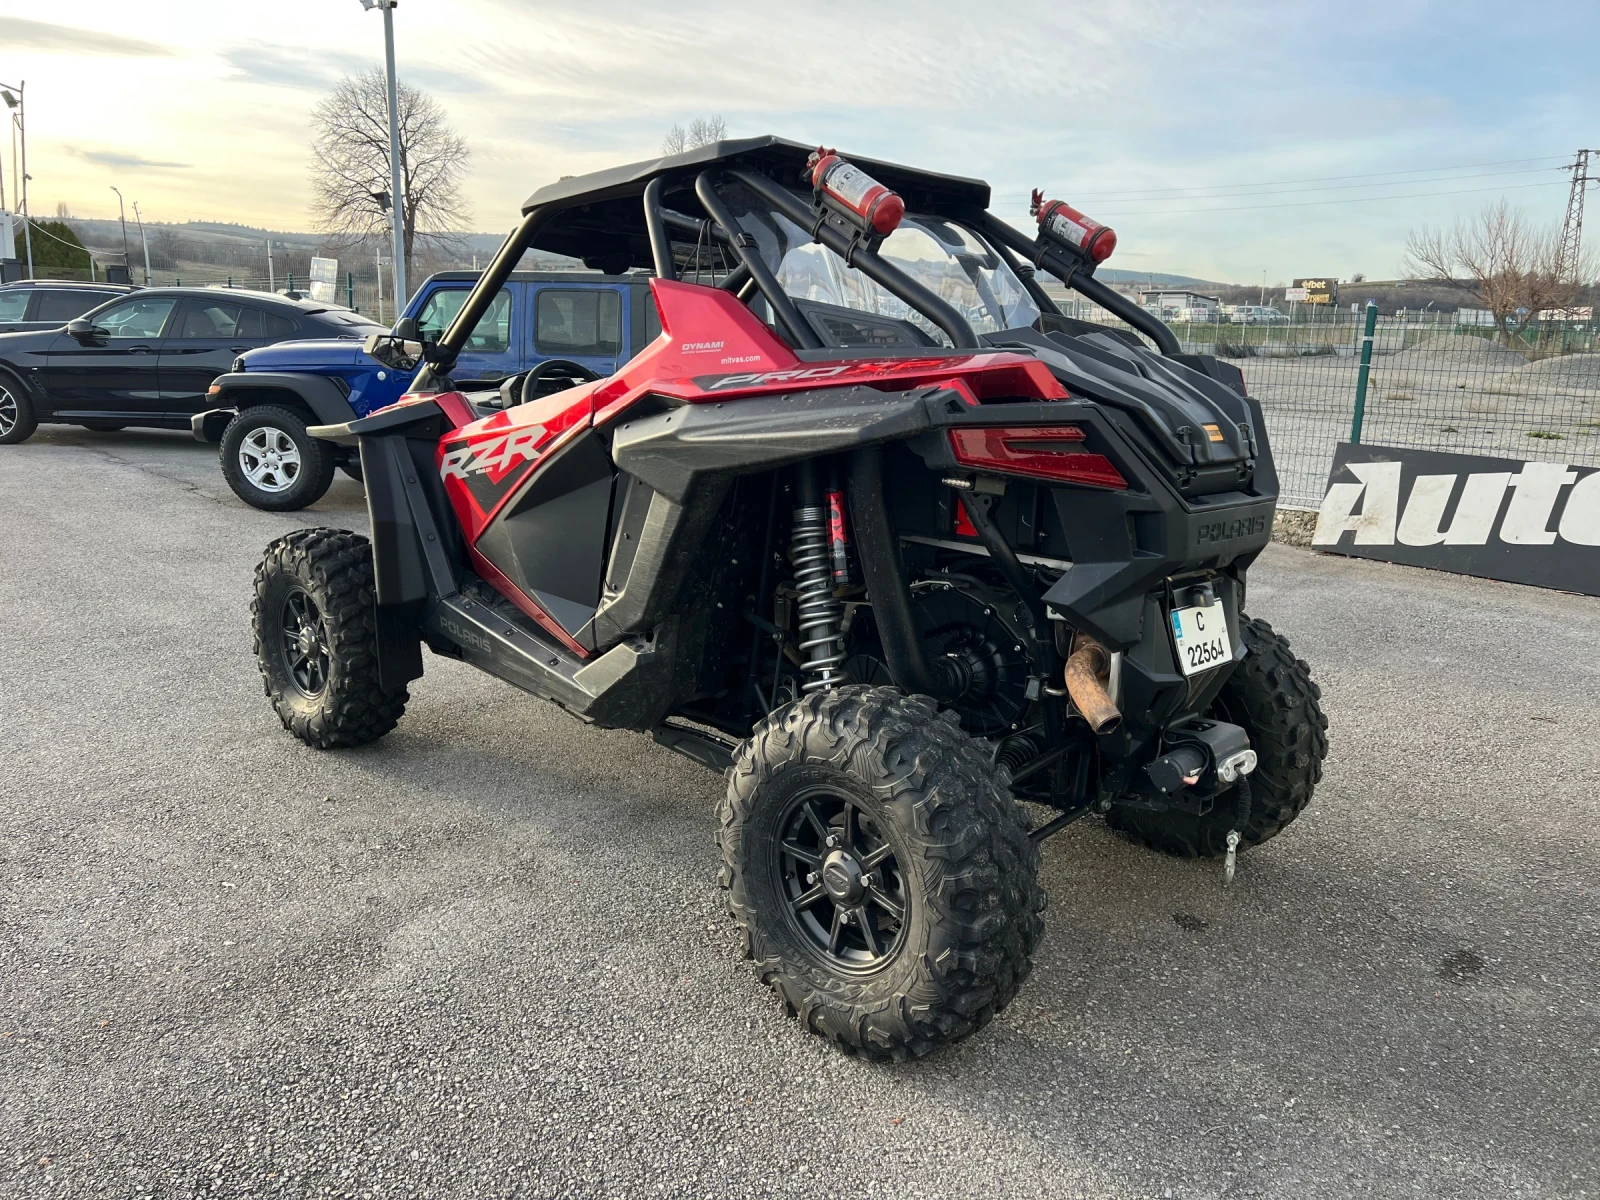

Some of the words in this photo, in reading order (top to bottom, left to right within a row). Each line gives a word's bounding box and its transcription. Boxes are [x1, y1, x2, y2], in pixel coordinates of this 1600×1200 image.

[721, 355, 760, 364] mitvas.com
[708, 366, 851, 389] PRO
[440, 424, 548, 483] RZR
[1196, 515, 1265, 546] POLARIS
[440, 617, 492, 653] POLARIS
[1196, 611, 1205, 632] C
[1187, 637, 1225, 668] 22564
